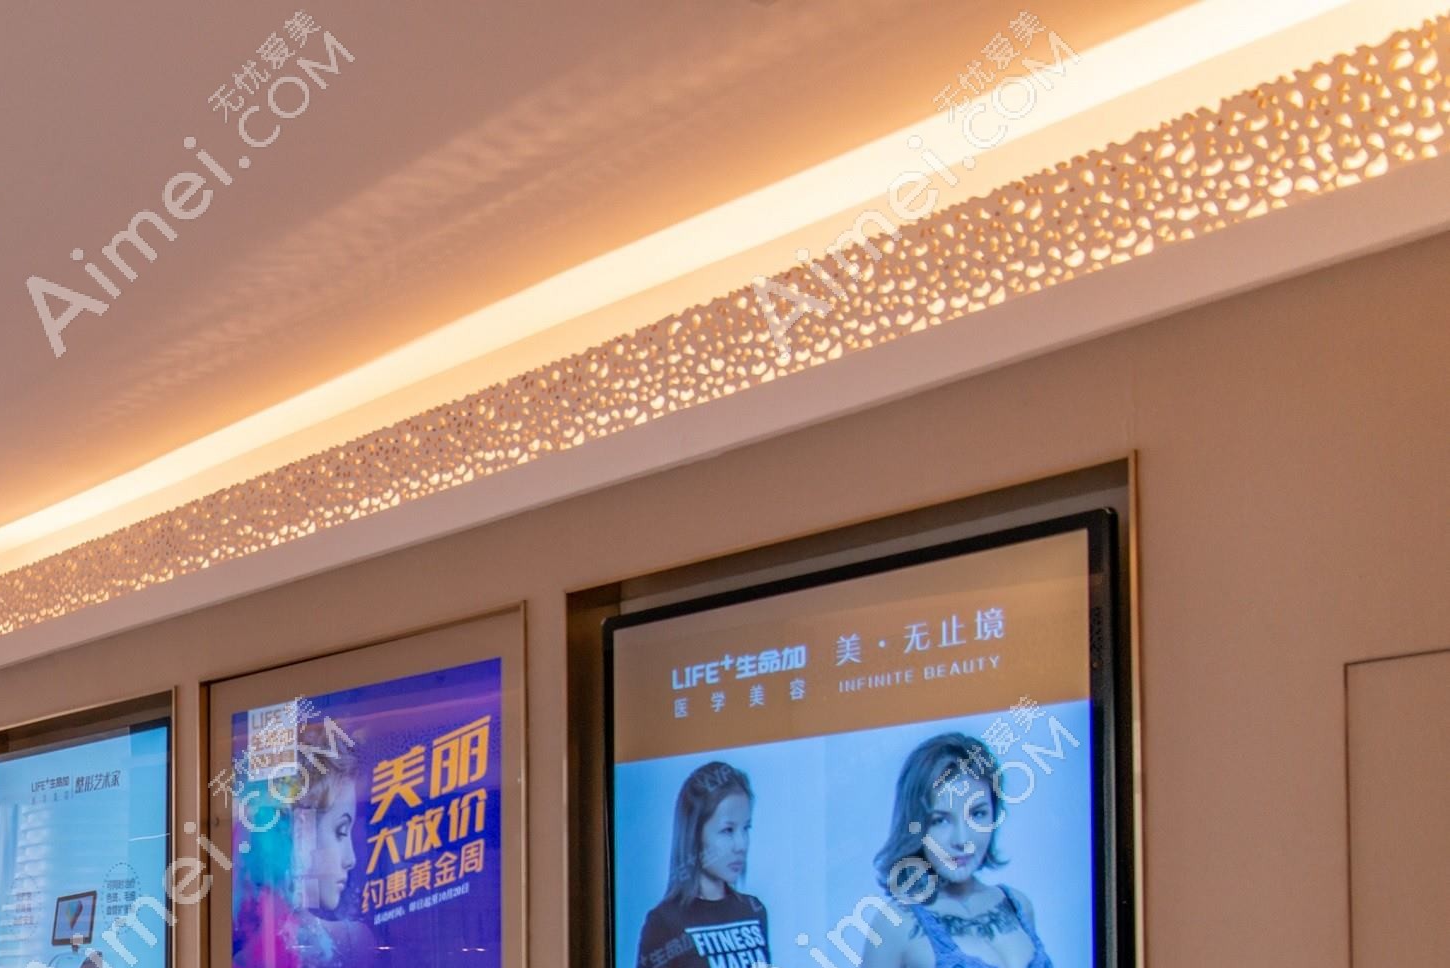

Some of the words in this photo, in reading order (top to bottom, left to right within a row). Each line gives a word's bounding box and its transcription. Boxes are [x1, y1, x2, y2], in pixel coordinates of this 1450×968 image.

[674, 678, 806, 719] 医学美容
[838, 669, 914, 694] INFINITE
[924, 655, 1001, 681] BEAUTY
[369, 714, 492, 825] 美丽
[365, 787, 488, 875] 大放价
[361, 838, 486, 914] 约惠黄金周
[691, 925, 766, 957] FITNESS
